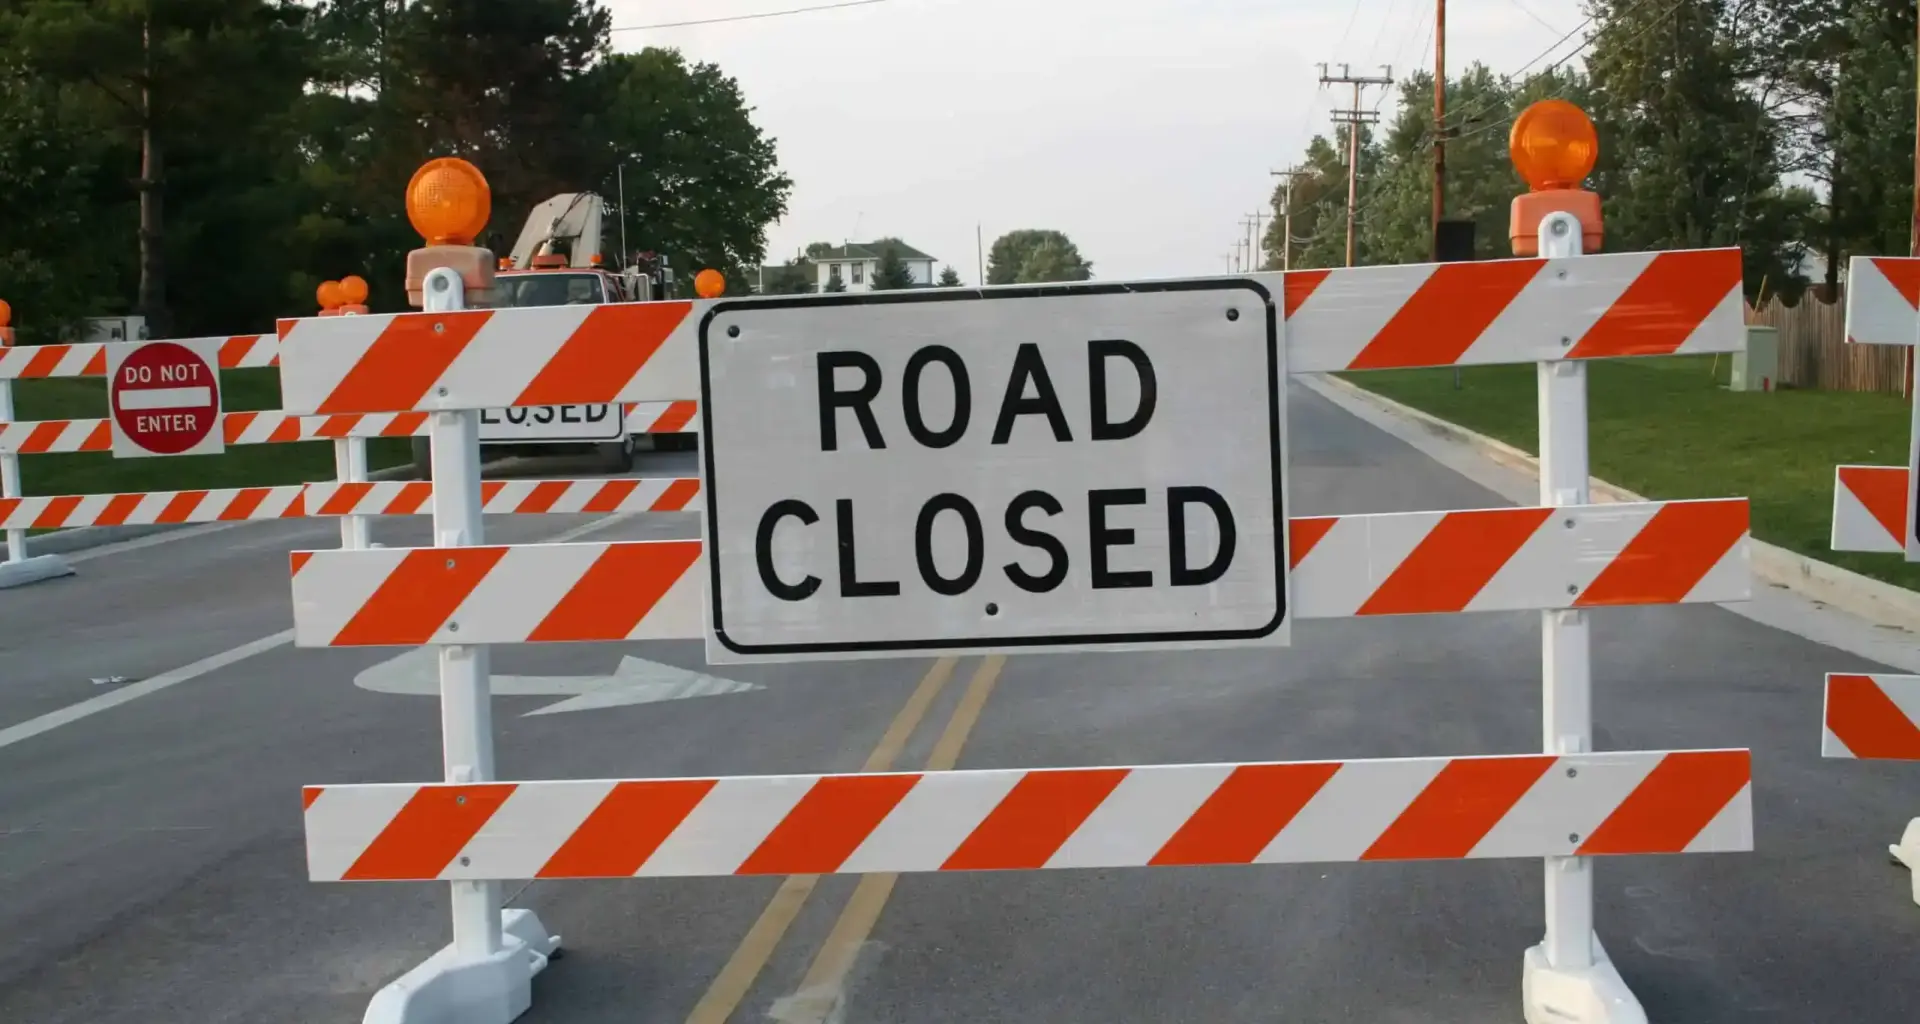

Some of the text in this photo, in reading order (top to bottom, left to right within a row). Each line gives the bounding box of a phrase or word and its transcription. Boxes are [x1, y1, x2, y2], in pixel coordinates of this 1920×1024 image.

[125, 363, 200, 383] DO NOT
[817, 339, 1158, 452] ROAD
[137, 414, 197, 433] ENTER
[480, 404, 608, 425] LOSED
[755, 485, 1237, 602] CLOSED
